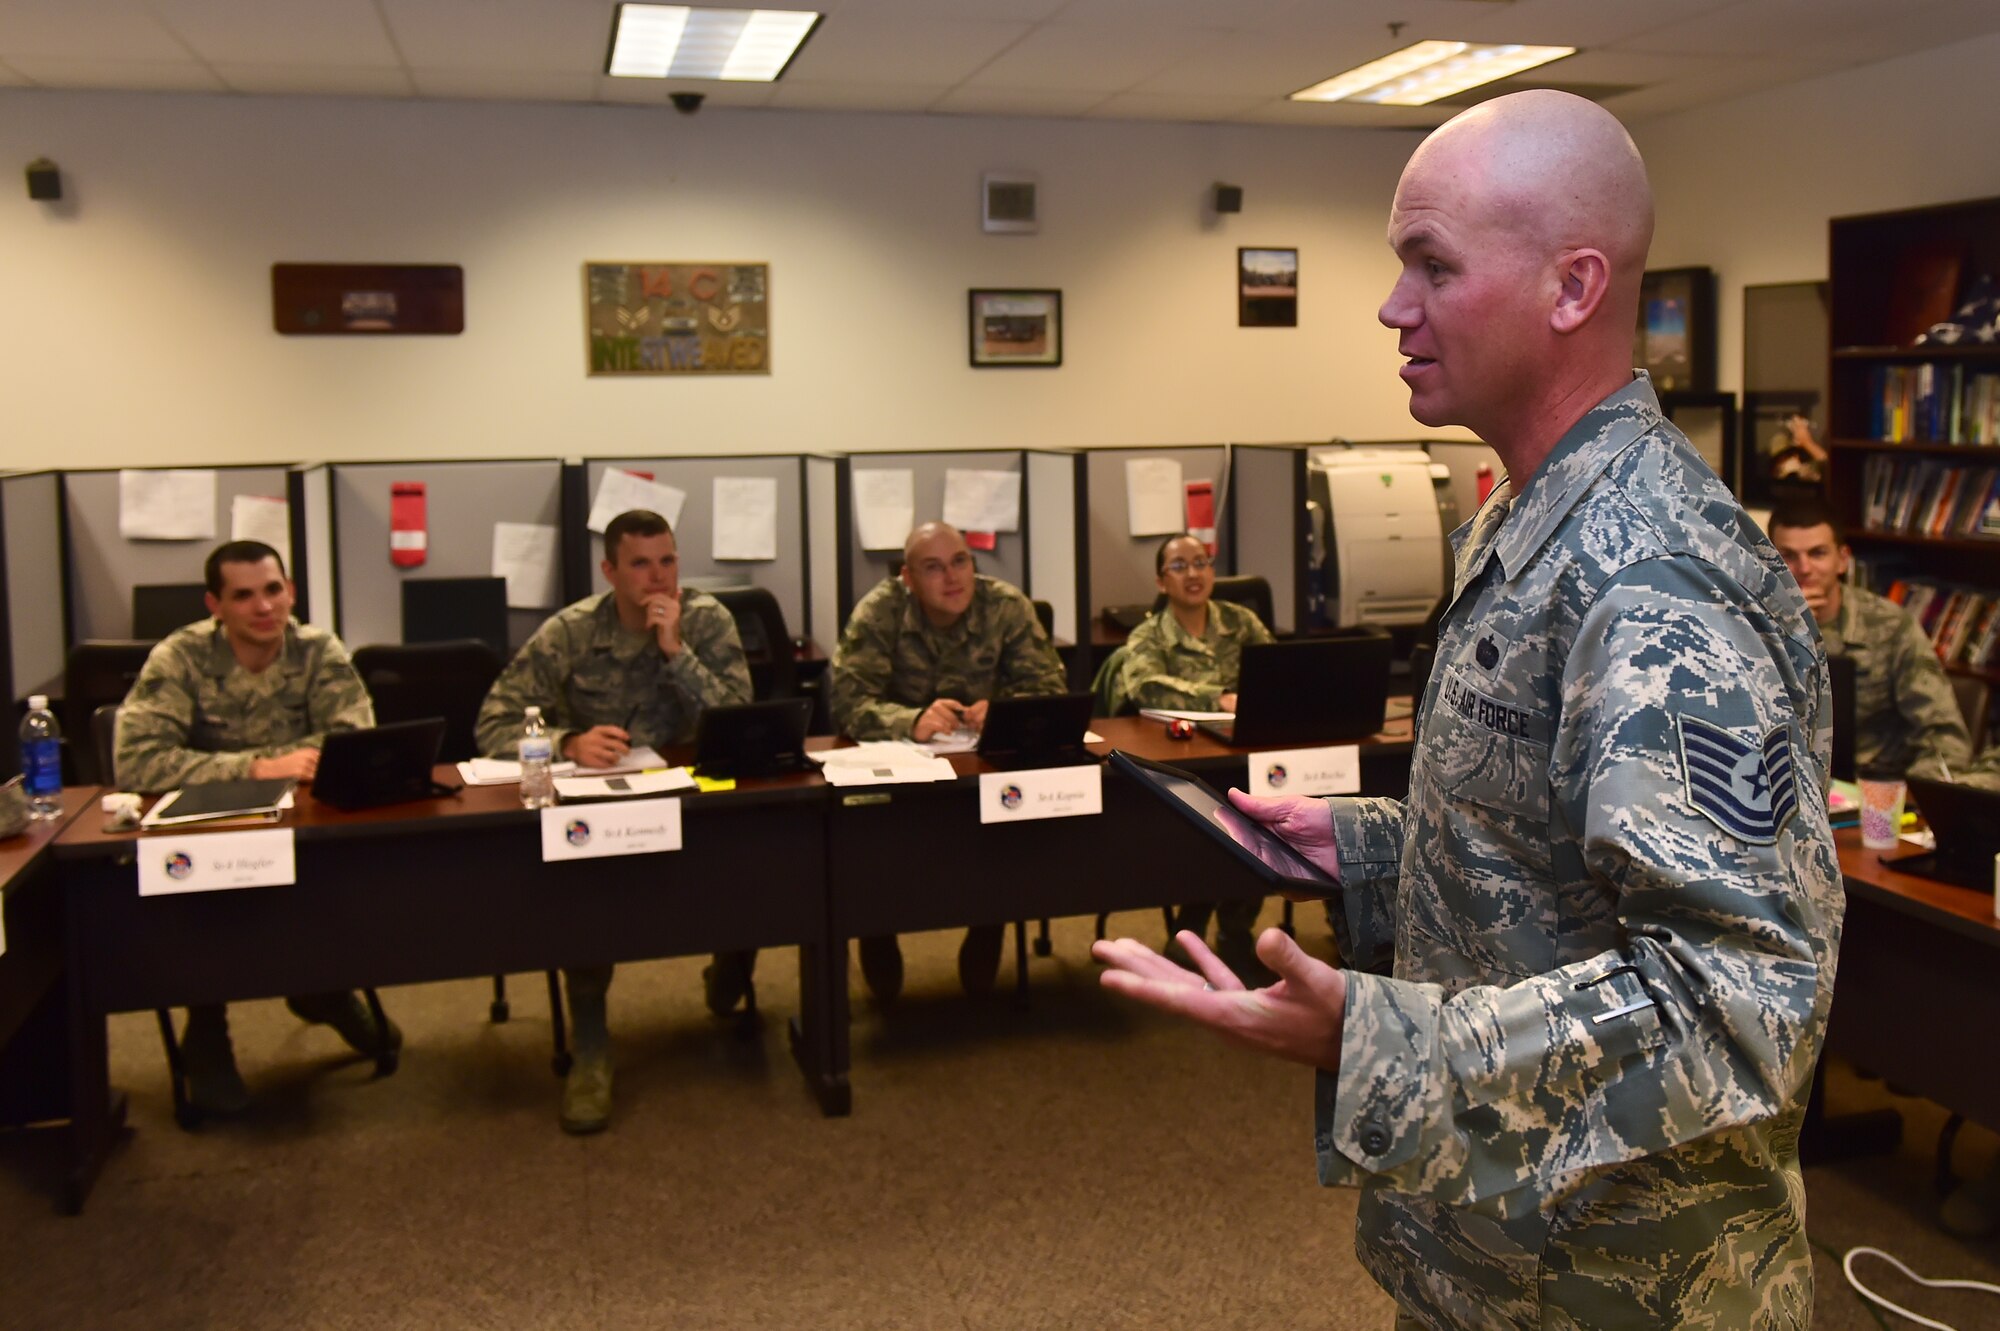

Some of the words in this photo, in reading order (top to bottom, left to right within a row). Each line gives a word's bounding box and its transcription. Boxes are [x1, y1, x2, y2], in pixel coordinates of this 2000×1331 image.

[640, 268, 671, 299] 14
[689, 267, 717, 299] C
[1444, 675, 1459, 706] U.S.
[1459, 687, 1476, 719] AIR
[1478, 697, 1530, 738] FORCE
